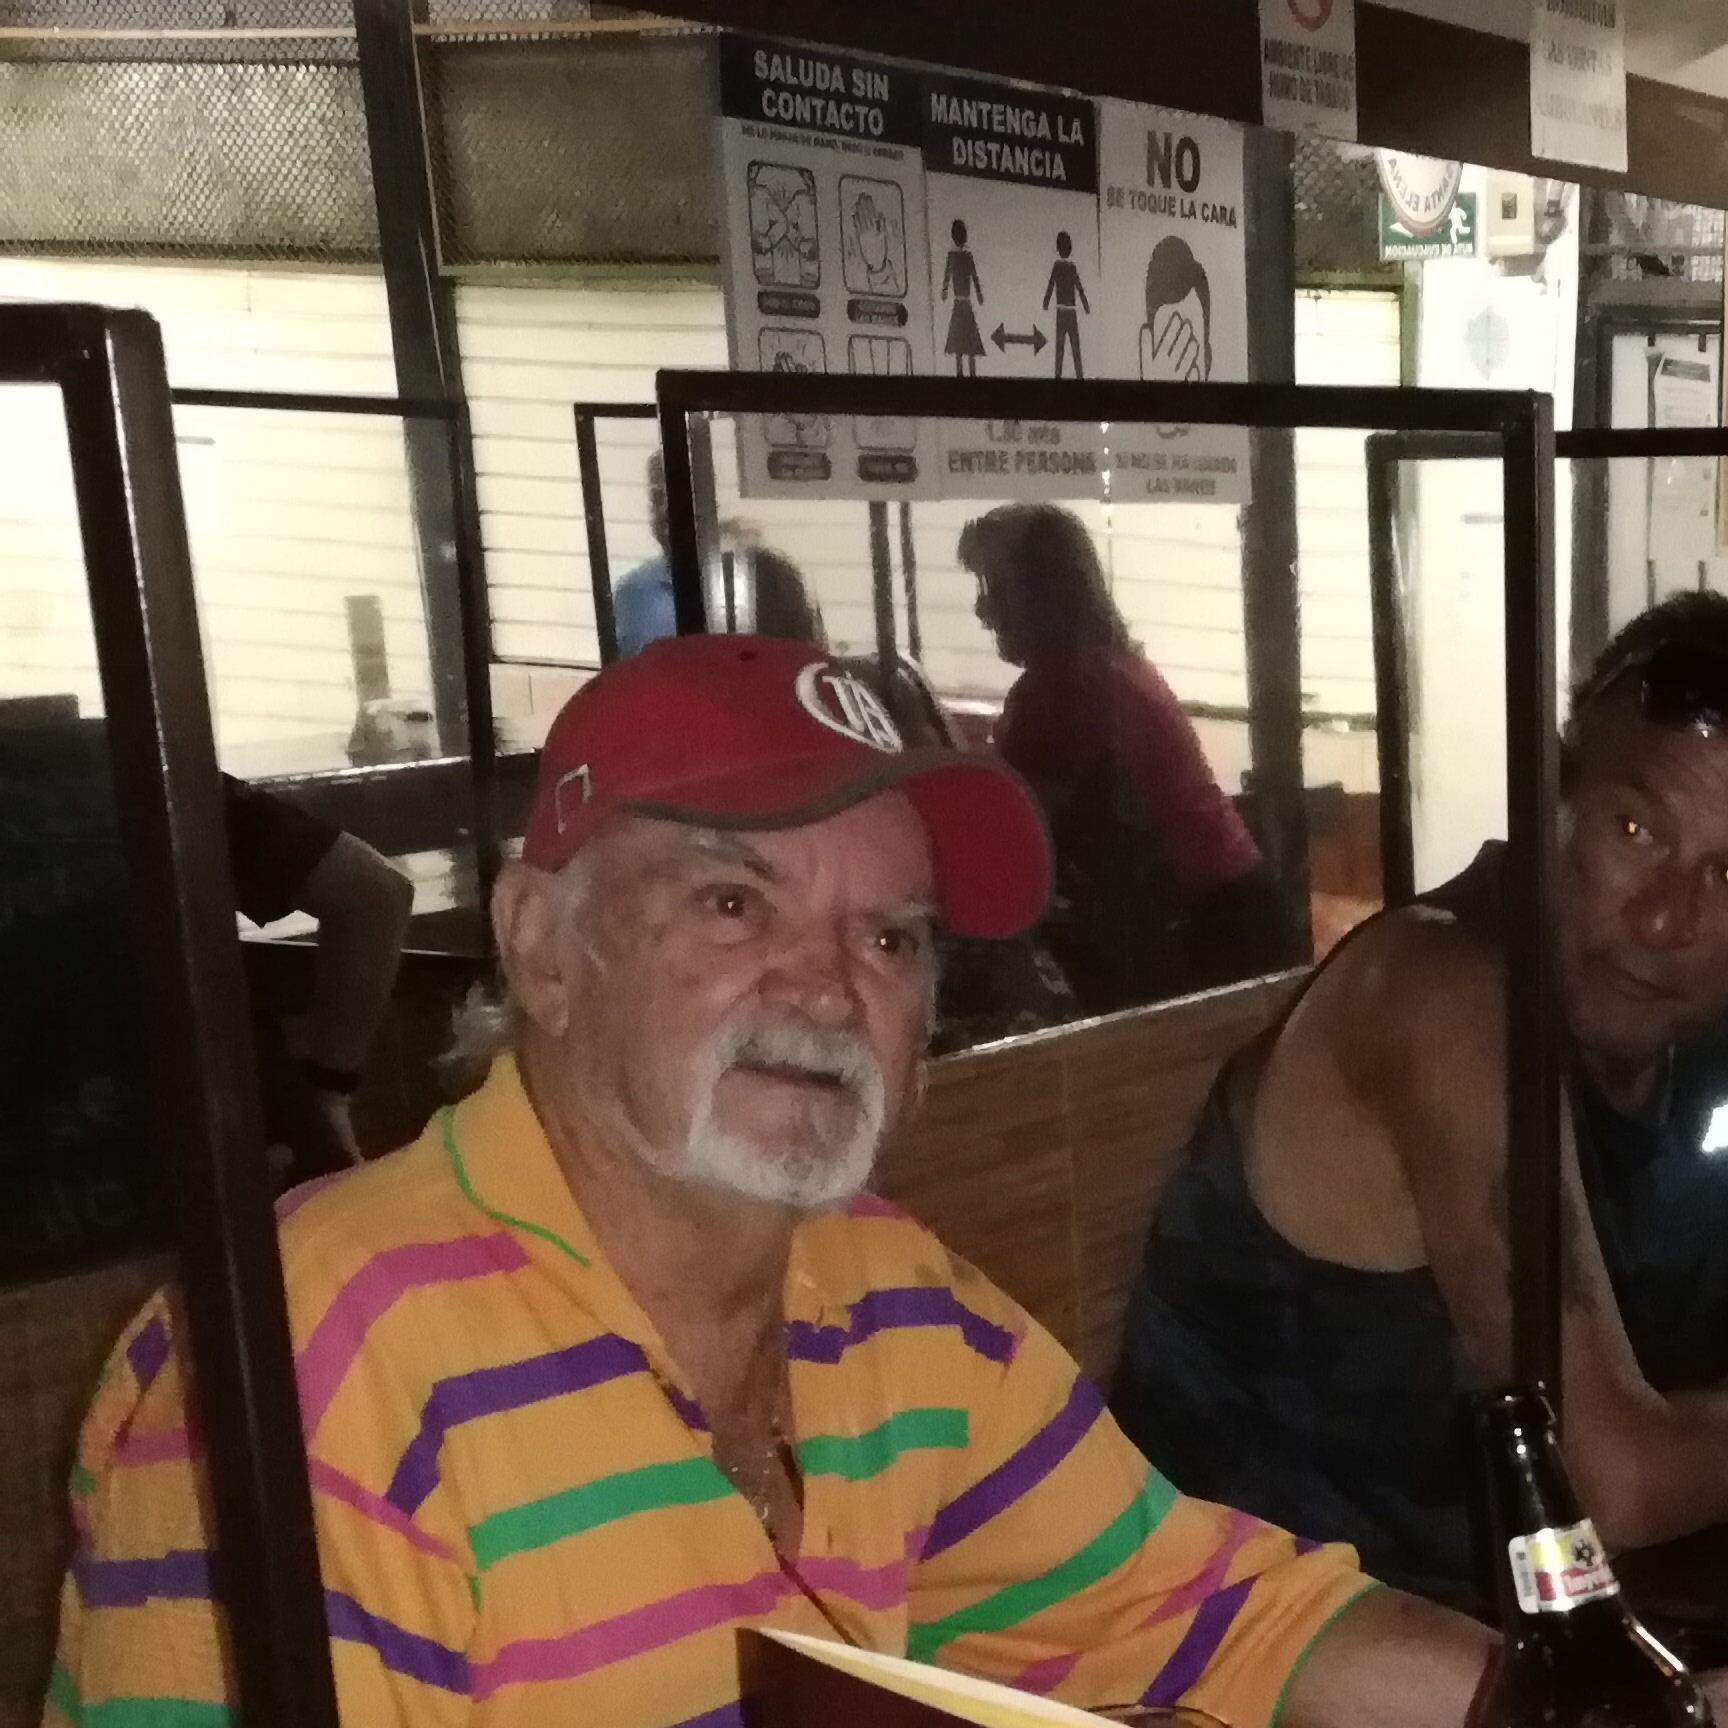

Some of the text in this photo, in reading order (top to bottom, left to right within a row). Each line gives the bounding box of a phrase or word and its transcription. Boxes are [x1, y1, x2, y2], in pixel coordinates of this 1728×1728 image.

[754, 49, 889, 101] SALUDA SIN
[761, 88, 884, 136] CONTACTO
[931, 92, 1085, 146] MANTENGA LA
[952, 136, 1066, 181] DISTANCIA
[1145, 130, 1201, 193] NO
[1129, 189, 1176, 217] TOQUE
[1179, 199, 1197, 220] LA
[1201, 203, 1238, 228] CARA
[949, 450, 1009, 473] ENTRE
